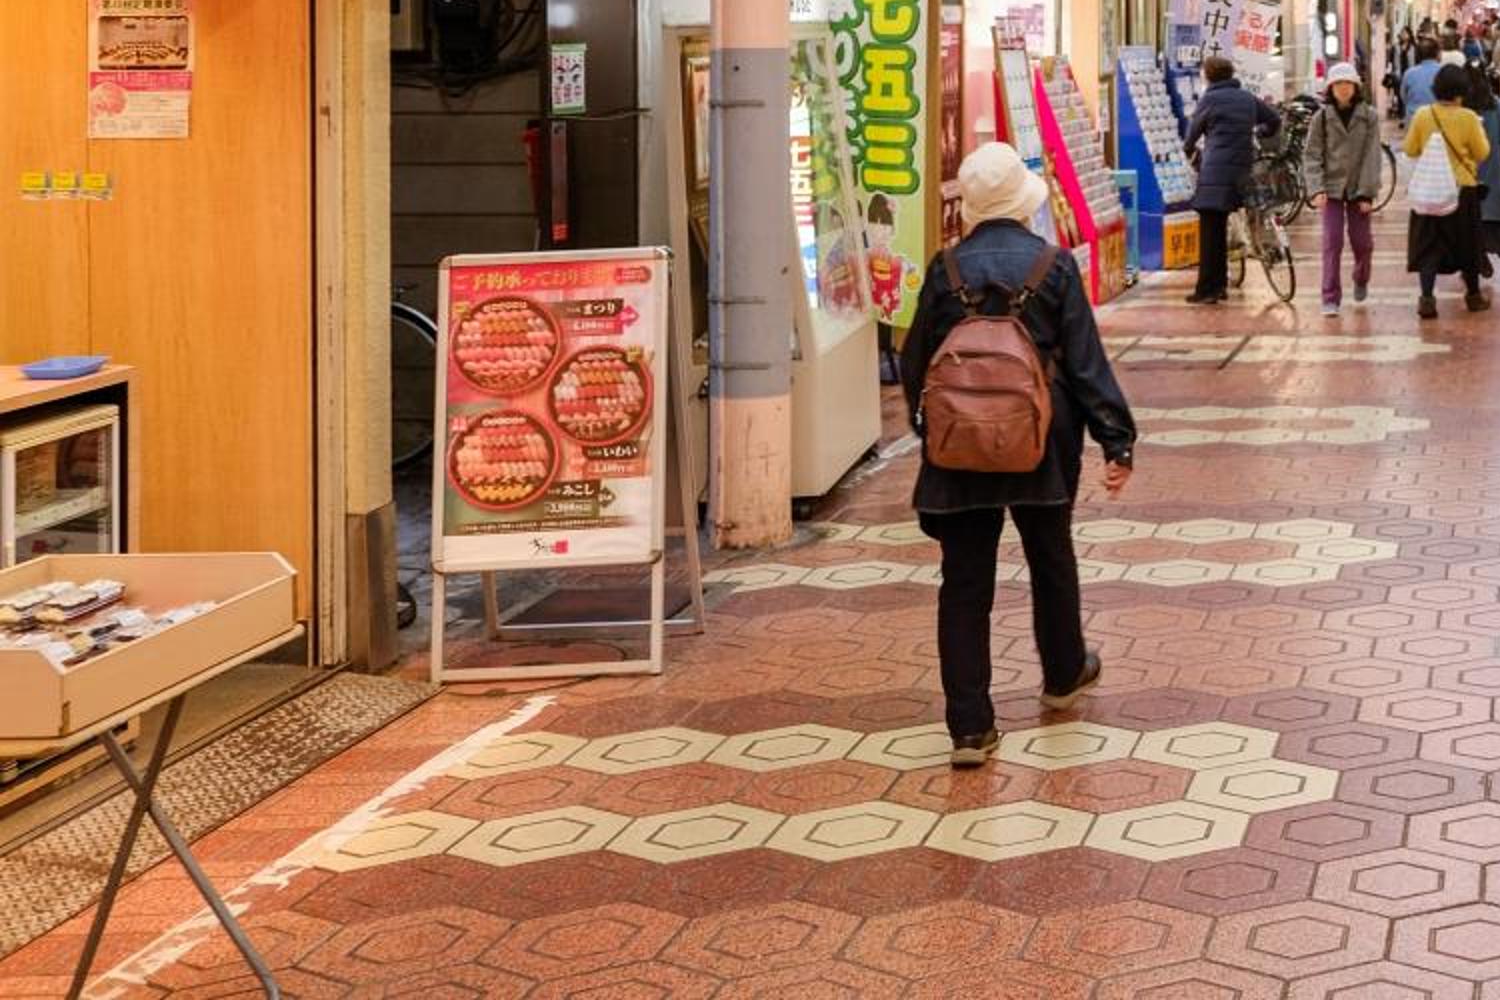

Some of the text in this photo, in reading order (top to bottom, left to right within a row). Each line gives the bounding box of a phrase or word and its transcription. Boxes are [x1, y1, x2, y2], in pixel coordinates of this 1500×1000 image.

[583, 301, 616, 316] まつり
[562, 483, 595, 496] みこし
